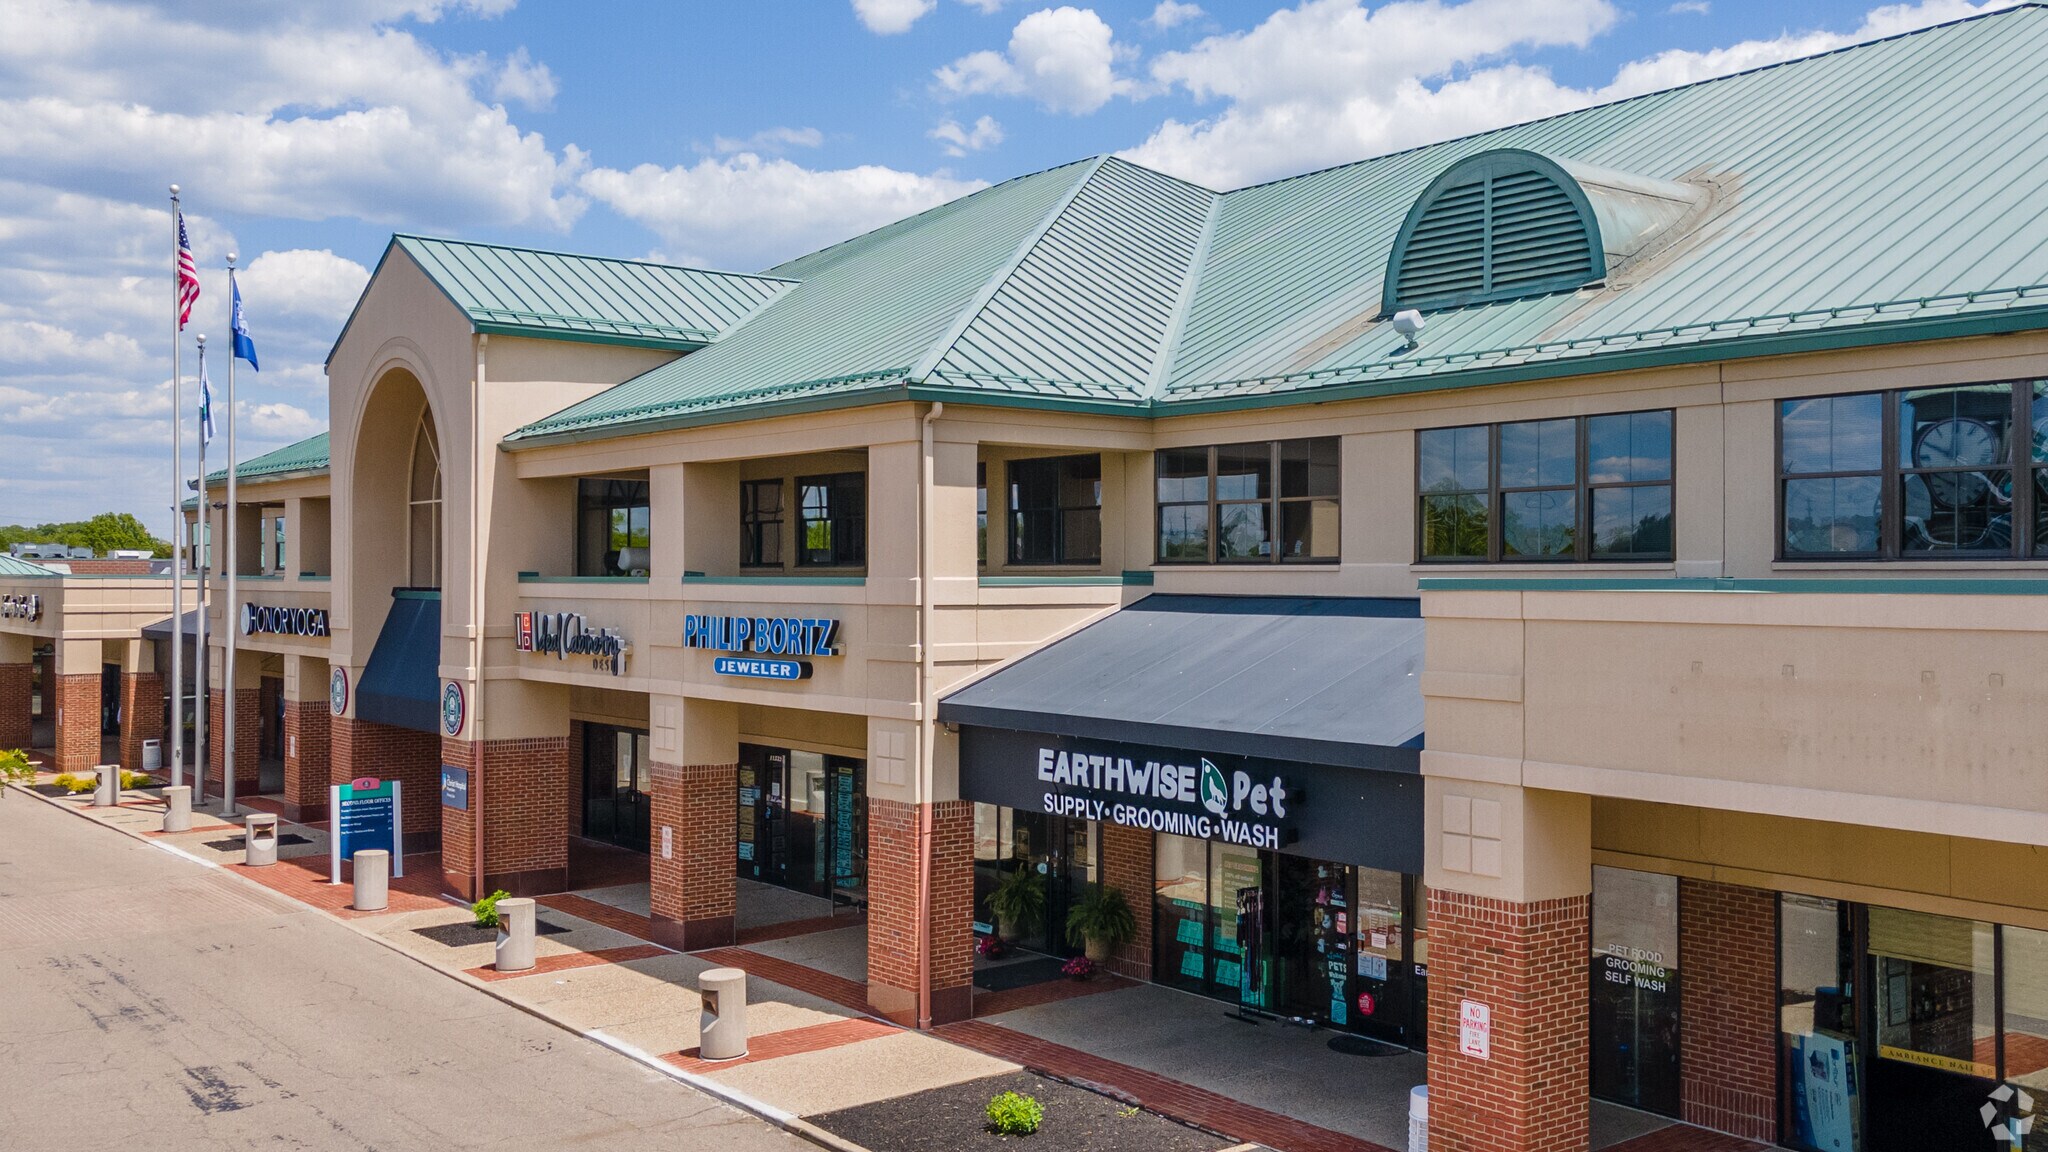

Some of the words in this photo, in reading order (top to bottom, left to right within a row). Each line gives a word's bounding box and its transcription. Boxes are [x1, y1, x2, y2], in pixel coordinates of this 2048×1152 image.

[684, 614, 750, 652] PHILIP
[755, 617, 832, 656] BORTZ
[720, 659, 791, 677] JEWELER
[1038, 748, 1196, 803] EARTHWISE
[1233, 770, 1286, 819] Pet
[1043, 792, 1104, 821] SUPPLY
[1113, 804, 1212, 838] GROOMING
[1220, 820, 1278, 850] WASH
[1609, 943, 1629, 957] PET
[1631, 948, 1663, 963] FOOD
[1414, 964, 1428, 977] Ea
[1606, 957, 1665, 978] GROOMING
[1605, 970, 1632, 985] SELF
[1634, 976, 1666, 993] WASH
[1470, 1007, 1481, 1019] NO
[1463, 1017, 1489, 1033] PARKING
[1888, 1049, 1944, 1067] AMBIANCE
